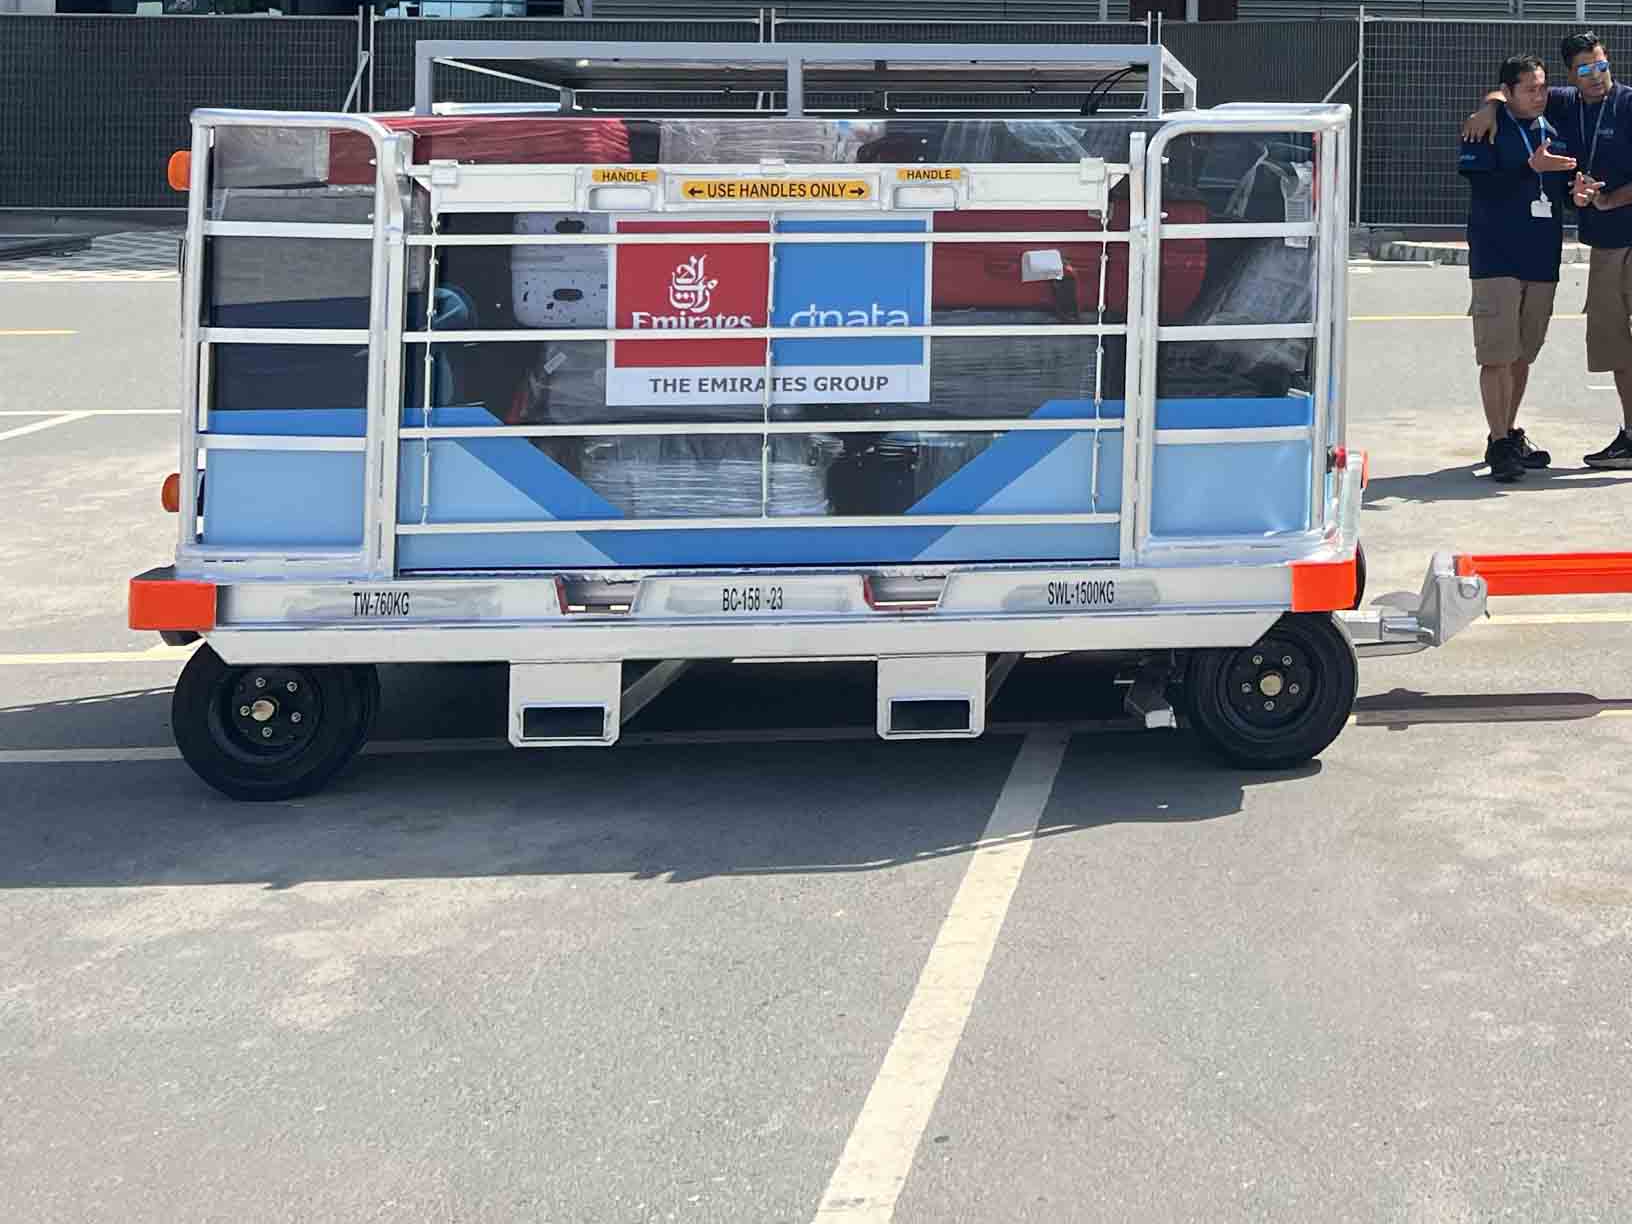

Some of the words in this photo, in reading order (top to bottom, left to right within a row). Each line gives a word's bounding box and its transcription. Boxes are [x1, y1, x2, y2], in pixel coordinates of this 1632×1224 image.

[602, 171, 648, 182] HANDLE
[906, 169, 952, 180] HANDLE
[708, 184, 736, 198] USE
[739, 183, 806, 198] HANDLES
[810, 183, 847, 198] ONLY
[790, 304, 909, 328] dnata
[649, 377, 691, 393] THE
[699, 377, 807, 393] EMIRATES
[814, 376, 889, 392] GROUP
[1048, 581, 1114, 605] SWL-1500KG
[353, 592, 410, 616] TW-760KG
